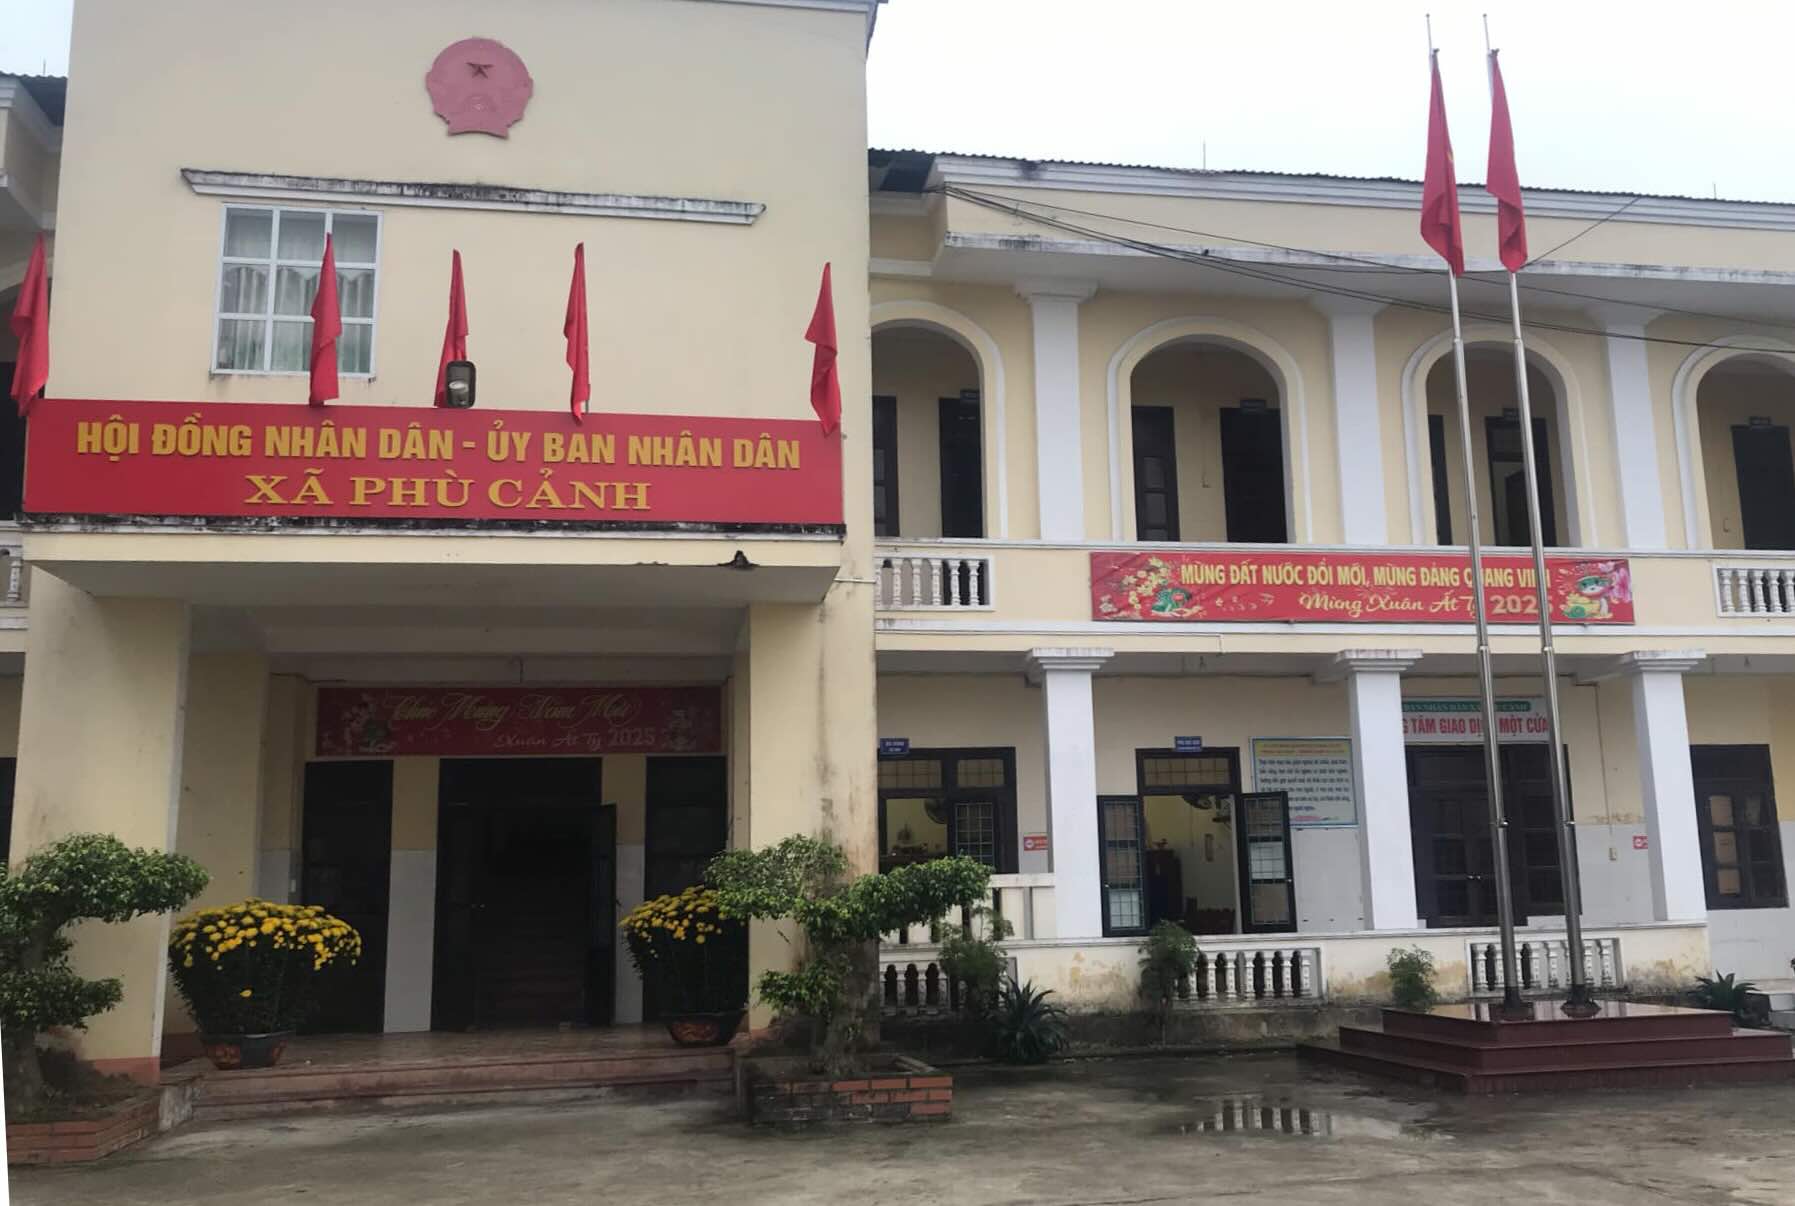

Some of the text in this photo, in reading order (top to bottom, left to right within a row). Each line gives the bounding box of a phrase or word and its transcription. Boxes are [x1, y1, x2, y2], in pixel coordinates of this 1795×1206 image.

[77, 414, 139, 461] HỘI
[151, 411, 252, 457] ĐỒNG
[264, 419, 367, 458] NHÂN
[378, 421, 454, 461] DÂN
[486, 419, 531, 462] ỦY
[543, 432, 616, 465] BAN
[627, 430, 723, 468] NHÂN
[732, 432, 802, 470] DÂN
[243, 468, 652, 511] XÃ PHÙ CẢNH
[1180, 560, 1226, 585] MỪNG
[1230, 559, 1258, 585] ĐẤT
[1262, 561, 1304, 585] NƯỚC
[1307, 556, 1334, 586] ĐỔI
[1373, 563, 1417, 587] MỪNG
[1420, 562, 1461, 588] ĐẢNG
[1365, 592, 1424, 613] Xuân
[1429, 589, 1460, 612] Ất
[608, 727, 657, 748] 2025
[1411, 714, 1437, 735] TÂM
[1439, 717, 1466, 734] GIAO
[1498, 714, 1523, 736] MỘT
